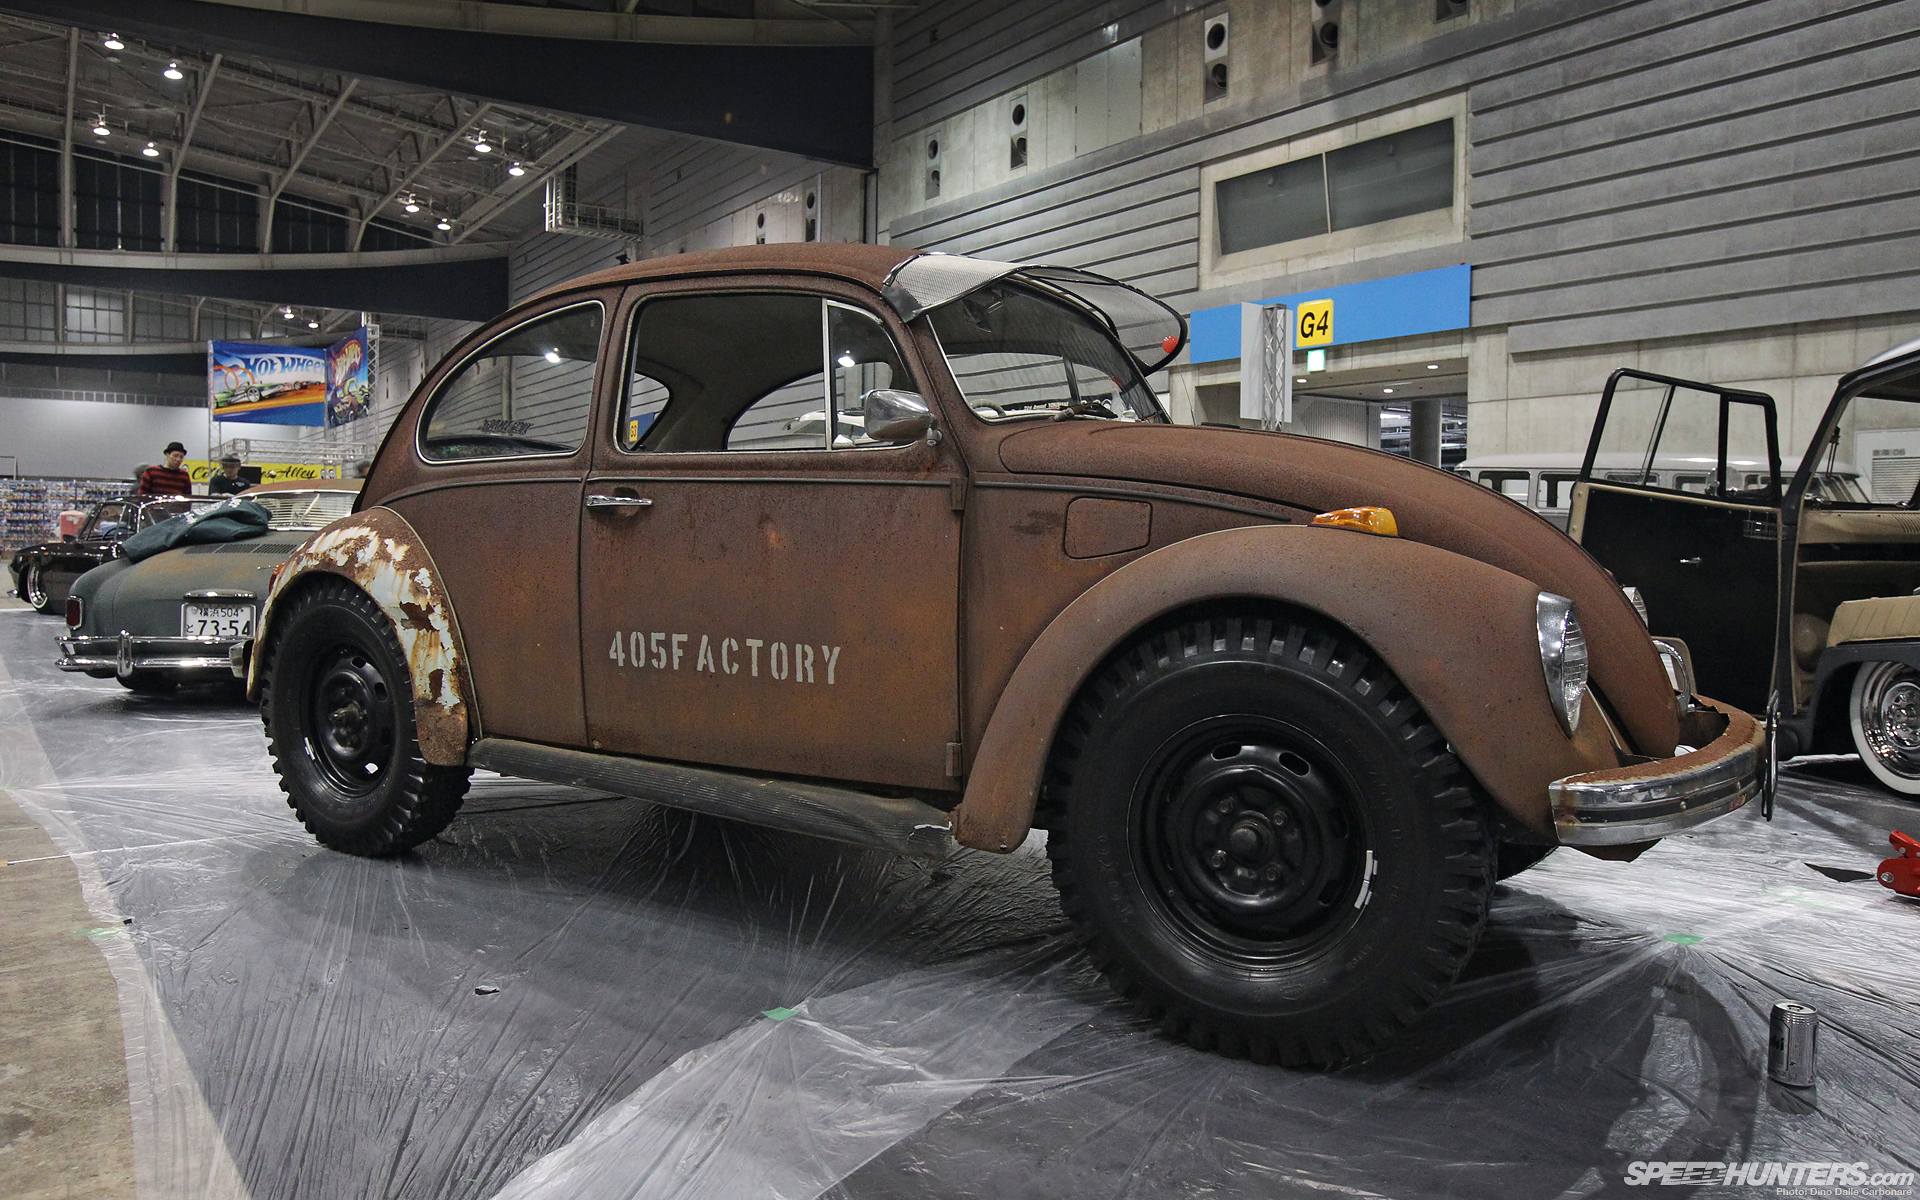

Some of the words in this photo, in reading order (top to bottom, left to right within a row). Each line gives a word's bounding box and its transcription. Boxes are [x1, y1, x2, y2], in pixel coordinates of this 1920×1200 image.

[1300, 310, 1329, 339] G4
[276, 466, 317, 479] Alley
[186, 623, 194, 633] と
[197, 619, 251, 636] 73-54
